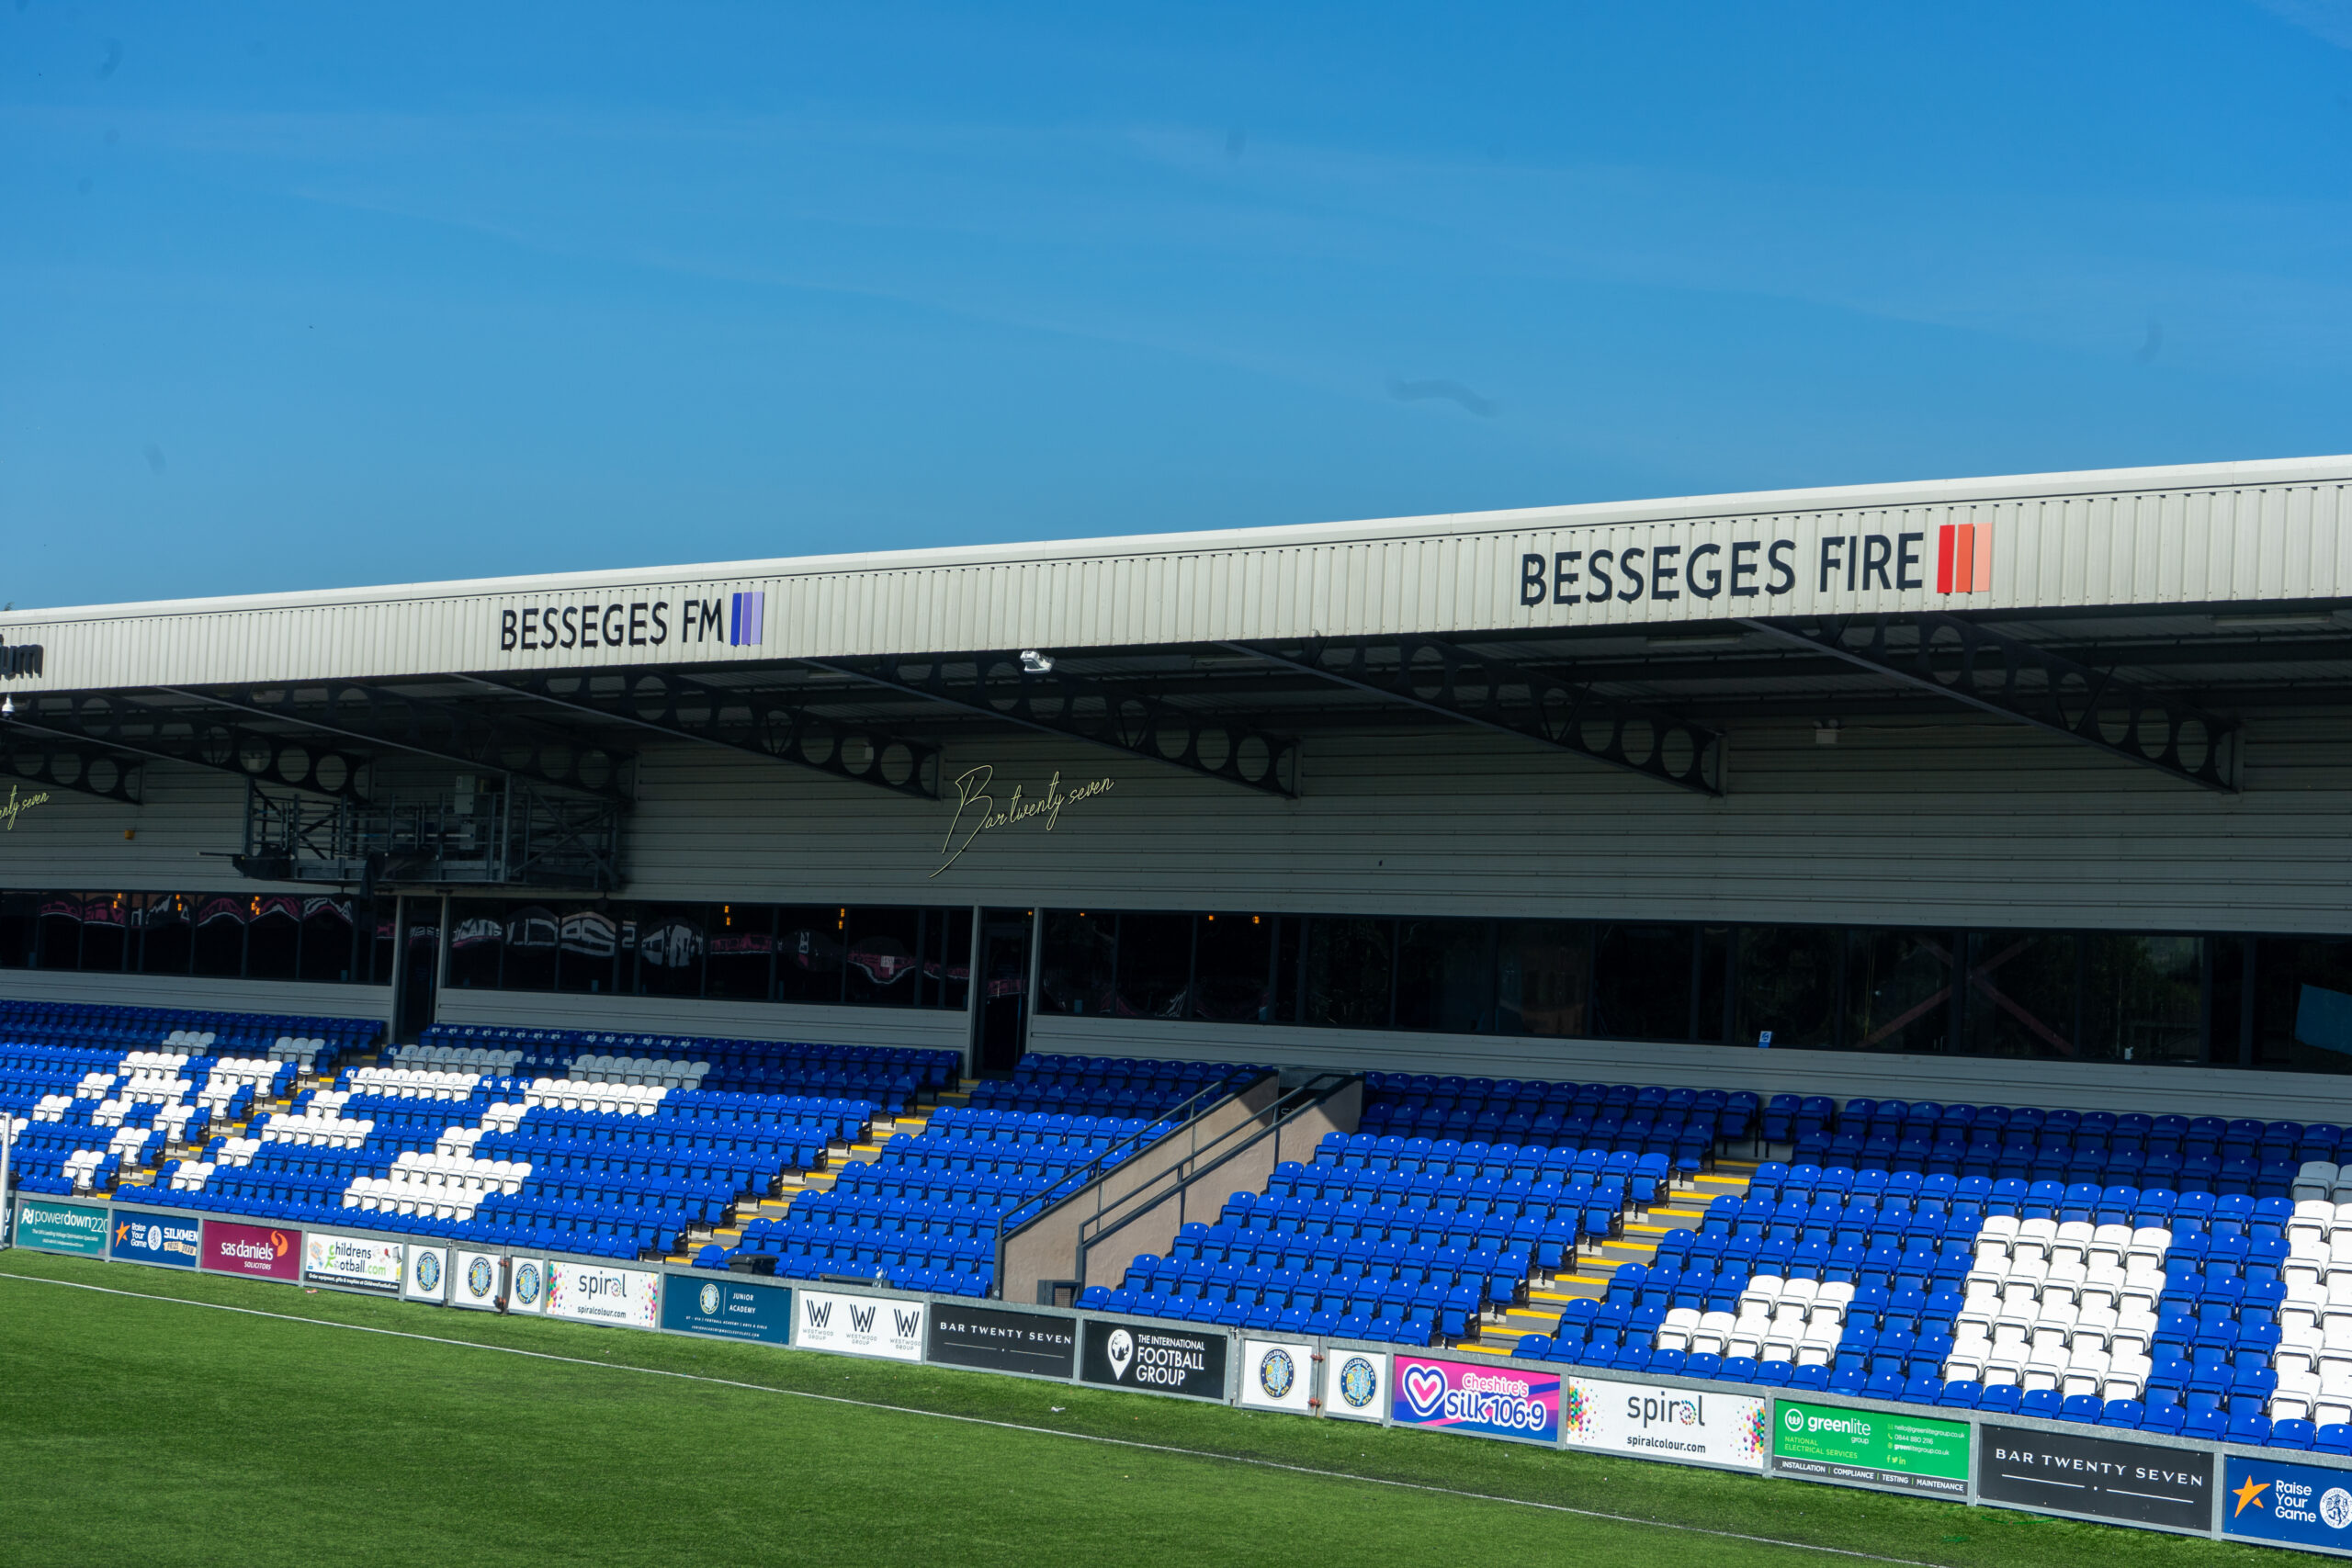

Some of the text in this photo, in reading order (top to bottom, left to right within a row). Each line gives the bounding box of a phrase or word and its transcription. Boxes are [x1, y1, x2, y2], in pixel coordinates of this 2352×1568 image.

[1521, 531, 1925, 607] BESSEGES FIRE
[501, 598, 724, 652] BESSEGES FM
[929, 764, 1008, 878] Bar
[1068, 777, 1115, 805] seven
[130, 1238, 147, 1247] Game
[131, 1231, 144, 1239] Your
[220, 1239, 274, 1261] sas daniels
[243, 1261, 272, 1270] SOLICITORS
[579, 1270, 627, 1300] spiral
[732, 1292, 753, 1301] JUNIOR
[578, 1305, 627, 1318] spiralcolour.com
[729, 1304, 756, 1314] ACADEMY
[802, 1328, 833, 1337] WESTWOOD
[846, 1333, 877, 1342] WESTWOOD
[940, 1321, 1071, 1344] BAR TWENTY SEVEN
[1137, 1334, 1204, 1350] THE INTERNATIONAL
[1137, 1347, 1204, 1370] FOOTBALL
[1136, 1364, 1186, 1386] GROUP
[1463, 1374, 1529, 1396] Cheshire's
[1627, 1391, 1705, 1428] spiral
[1808, 1416, 1871, 1436] greenlite
[1627, 1436, 1706, 1453] spiralcolour.com
[1784, 1436, 1818, 1447] NATIONAL
[1851, 1436, 1870, 1445] group
[1784, 1444, 1858, 1459] ELECTRICAL SERVICES
[1996, 1448, 2202, 1487] BAR TWENTY SEVEN
[1782, 1461, 1964, 1492] INSTALLATION COMPLIANCE TESTING MAINTENANCE
[2276, 1480, 2312, 1496] Raise
[2275, 1493, 2308, 1508] Your
[2275, 1506, 2317, 1522] Game
